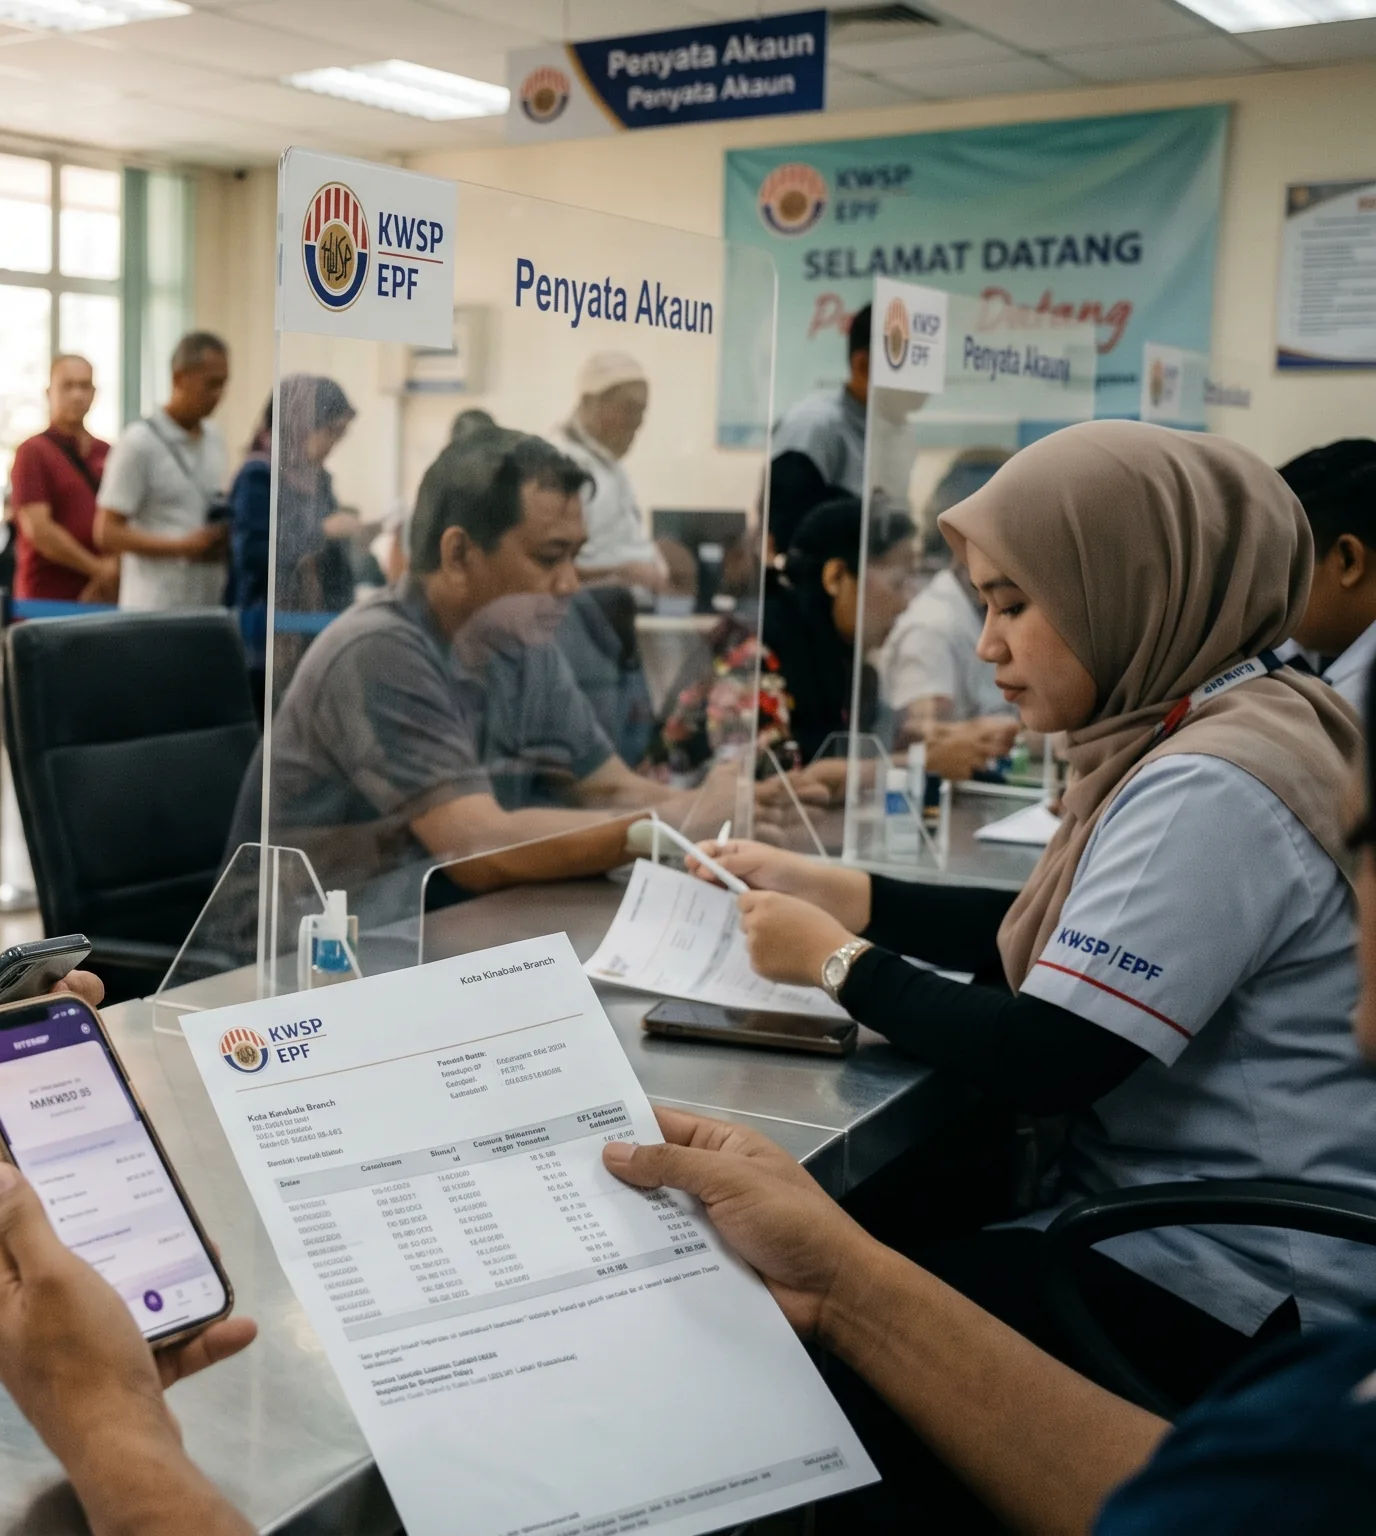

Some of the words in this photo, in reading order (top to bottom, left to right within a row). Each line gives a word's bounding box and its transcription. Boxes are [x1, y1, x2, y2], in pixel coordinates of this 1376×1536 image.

[608, 41, 716, 80] Penyata
[721, 31, 815, 65] Akaun
[627, 79, 717, 112] Penyata
[720, 72, 796, 101] Akaun
[835, 164, 914, 191] KWSP
[377, 211, 444, 254] KWSP
[804, 240, 973, 281] SELAMAT
[982, 230, 1143, 271] DATANG
[377, 263, 419, 300] EPF
[515, 257, 627, 328] Penyata
[634, 279, 714, 335] Akaun
[963, 334, 1020, 382] Penyata
[459, 974, 482, 986] Kota
[523, 956, 556, 970] Branch
[1056, 926, 1111, 957] KWSP
[1118, 951, 1164, 982] EPF
[268, 1018, 323, 1042] KWSP
[276, 1043, 310, 1063] EPF
[247, 1113, 268, 1122] Kota
[306, 1098, 336, 1111] Branch
